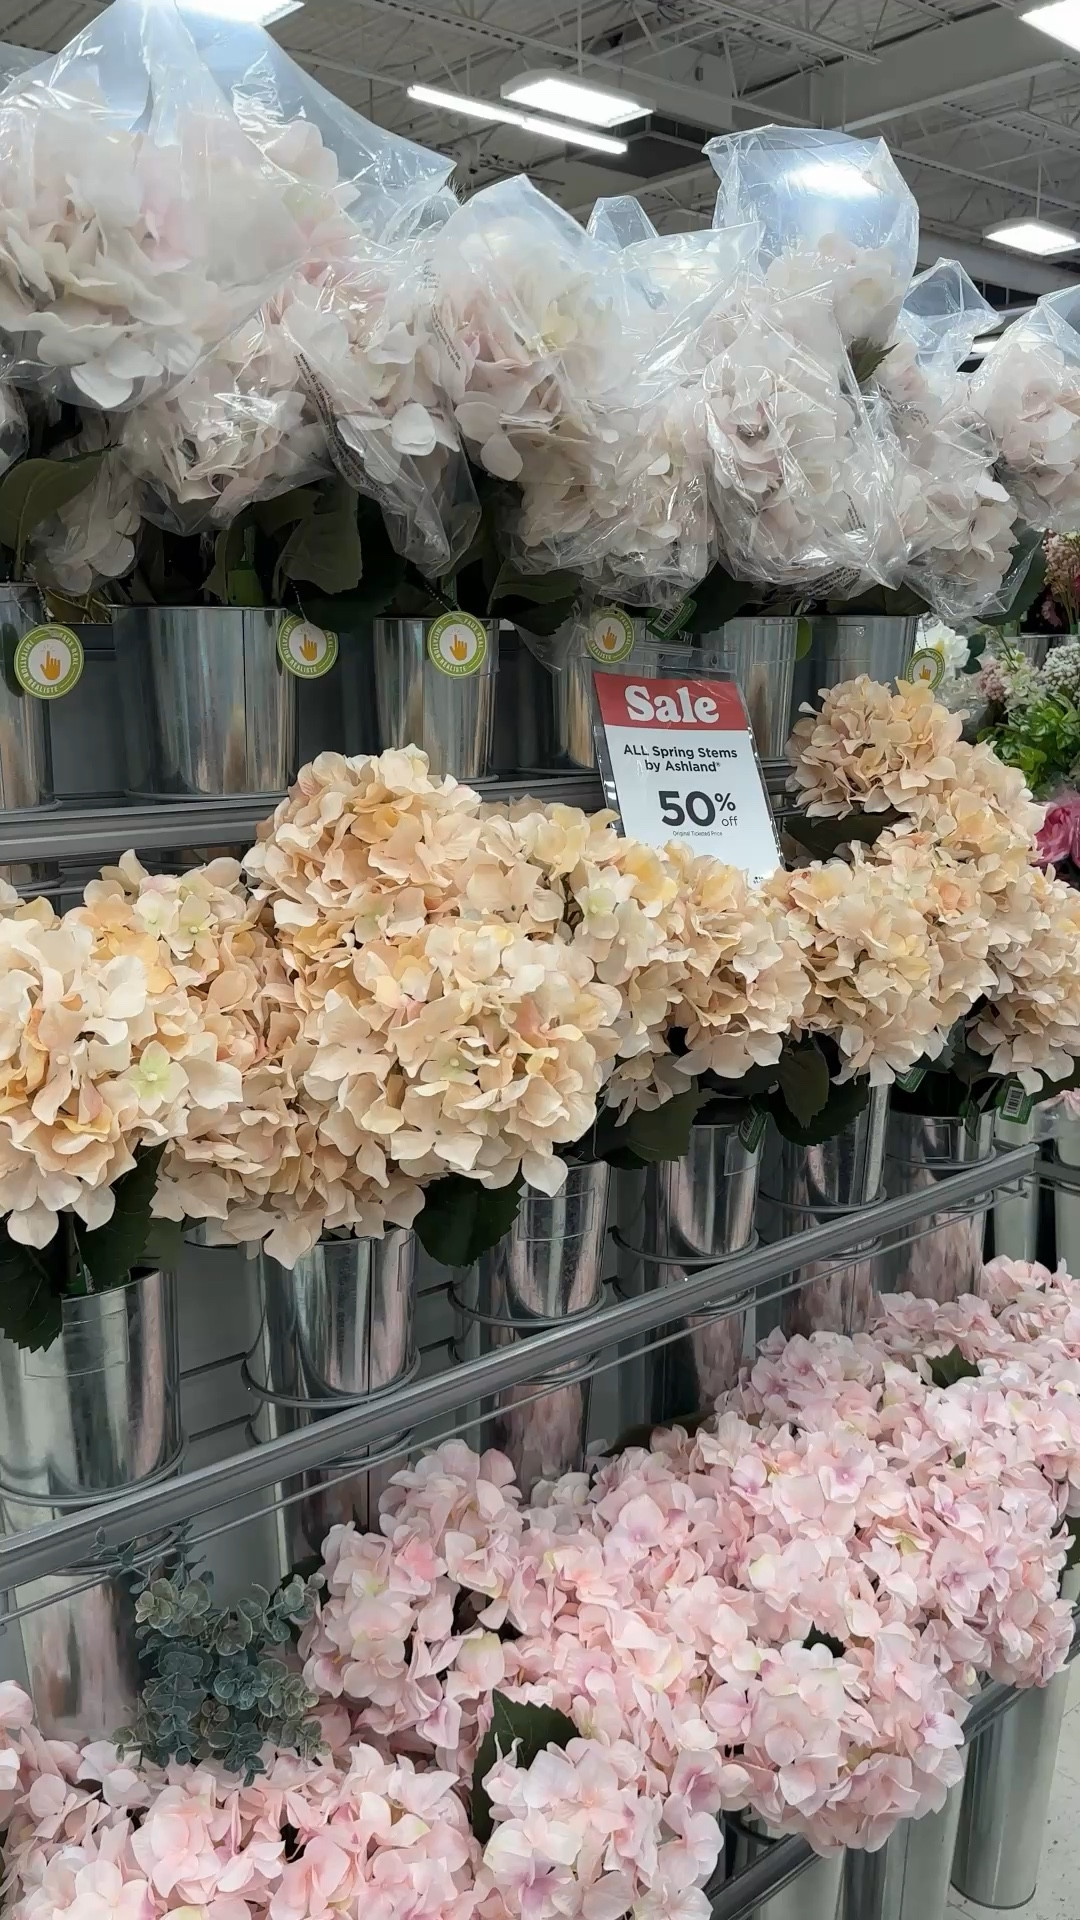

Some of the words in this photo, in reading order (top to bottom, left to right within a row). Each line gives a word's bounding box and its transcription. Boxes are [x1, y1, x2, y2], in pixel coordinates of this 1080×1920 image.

[282, 624, 293, 660] IMITATION
[432, 625, 443, 659] IMITATION
[464, 618, 478, 632] FAUX
[476, 632, 484, 648] REAL
[20, 640, 34, 679] IMITATION
[71, 647, 79, 666] REAL
[624, 685, 720, 724] Sale
[623, 744, 650, 756] ALL
[652, 745, 695, 760] Spring
[697, 747, 738, 758] Stems
[644, 759, 661, 773] by
[658, 790, 736, 827] 50%
[721, 815, 738, 827] off
